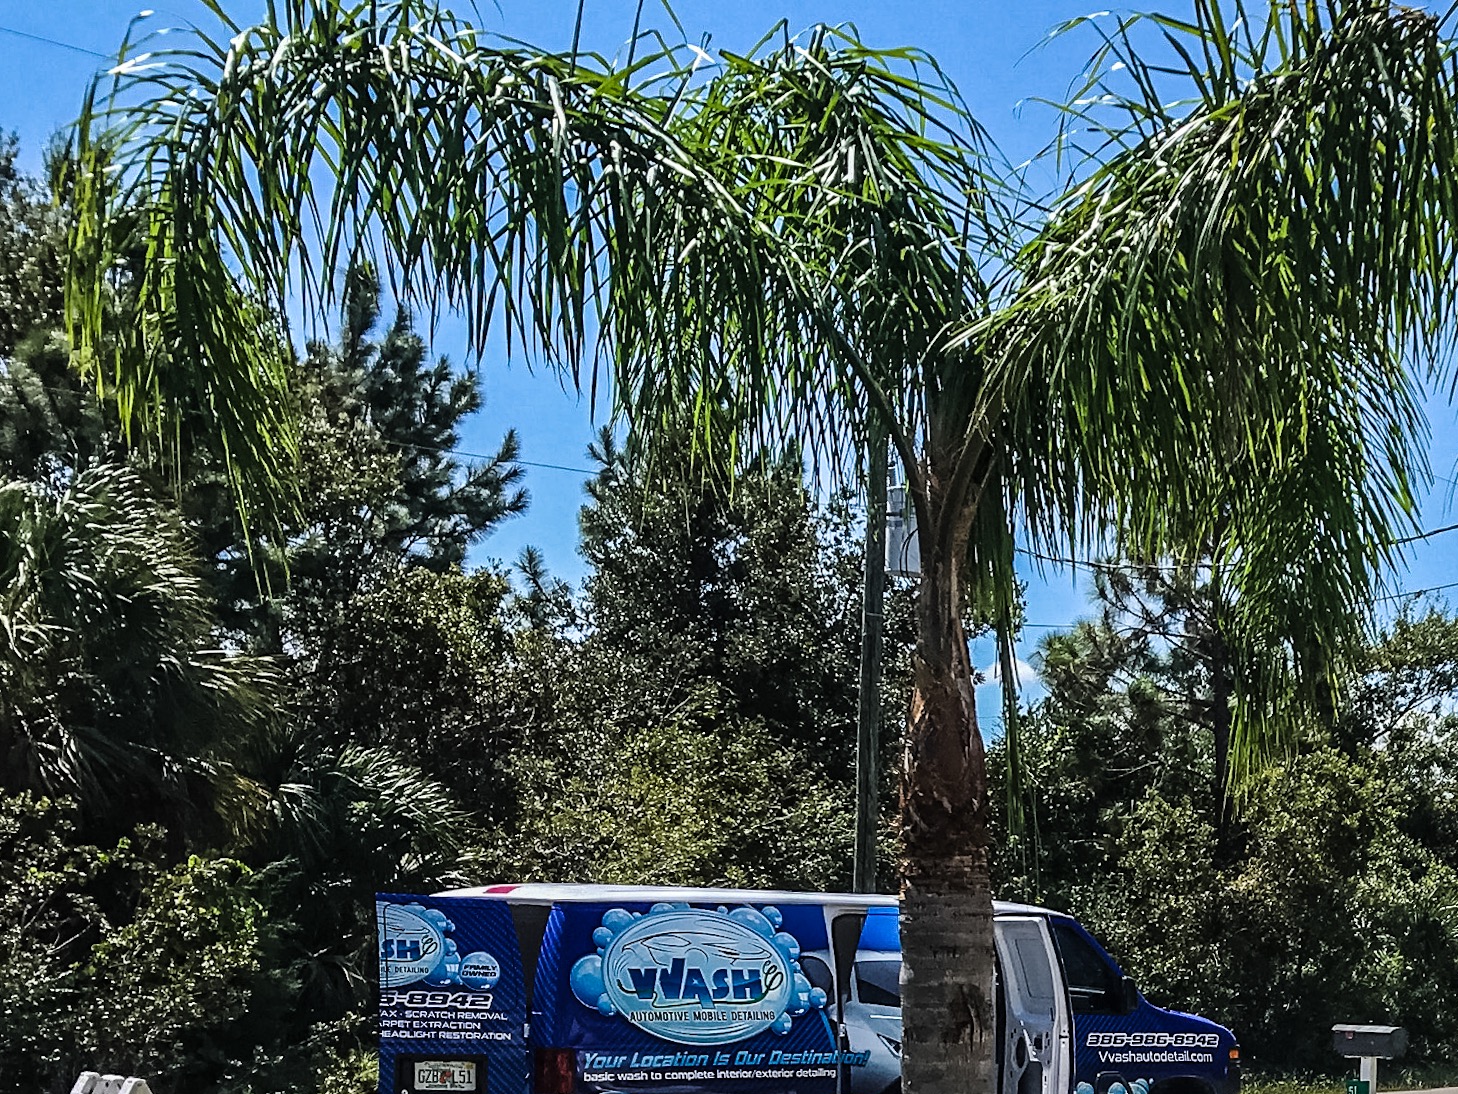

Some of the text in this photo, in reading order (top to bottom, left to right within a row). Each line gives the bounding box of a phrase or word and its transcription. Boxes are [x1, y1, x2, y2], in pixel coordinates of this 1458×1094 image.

[405, 1010, 455, 1019] SCRATCH
[457, 1012, 508, 1020] REMOVAL
[630, 1011, 775, 1021] AUTOMOTIVE MOBILE DETAILING
[413, 1021, 481, 1030] EXTRACTION
[439, 1031, 512, 1040] RESTORATION
[1086, 1032, 1219, 1048] 386-986-8942
[584, 1052, 628, 1069] Your
[629, 1051, 710, 1069] Location
[712, 1051, 732, 1066] Is
[734, 1050, 765, 1066] Our
[583, 1071, 615, 1082] basic
[620, 1070, 648, 1081] wash
[650, 1071, 662, 1080] to
[664, 1069, 715, 1081] complete
[796, 1067, 836, 1079] detailing
